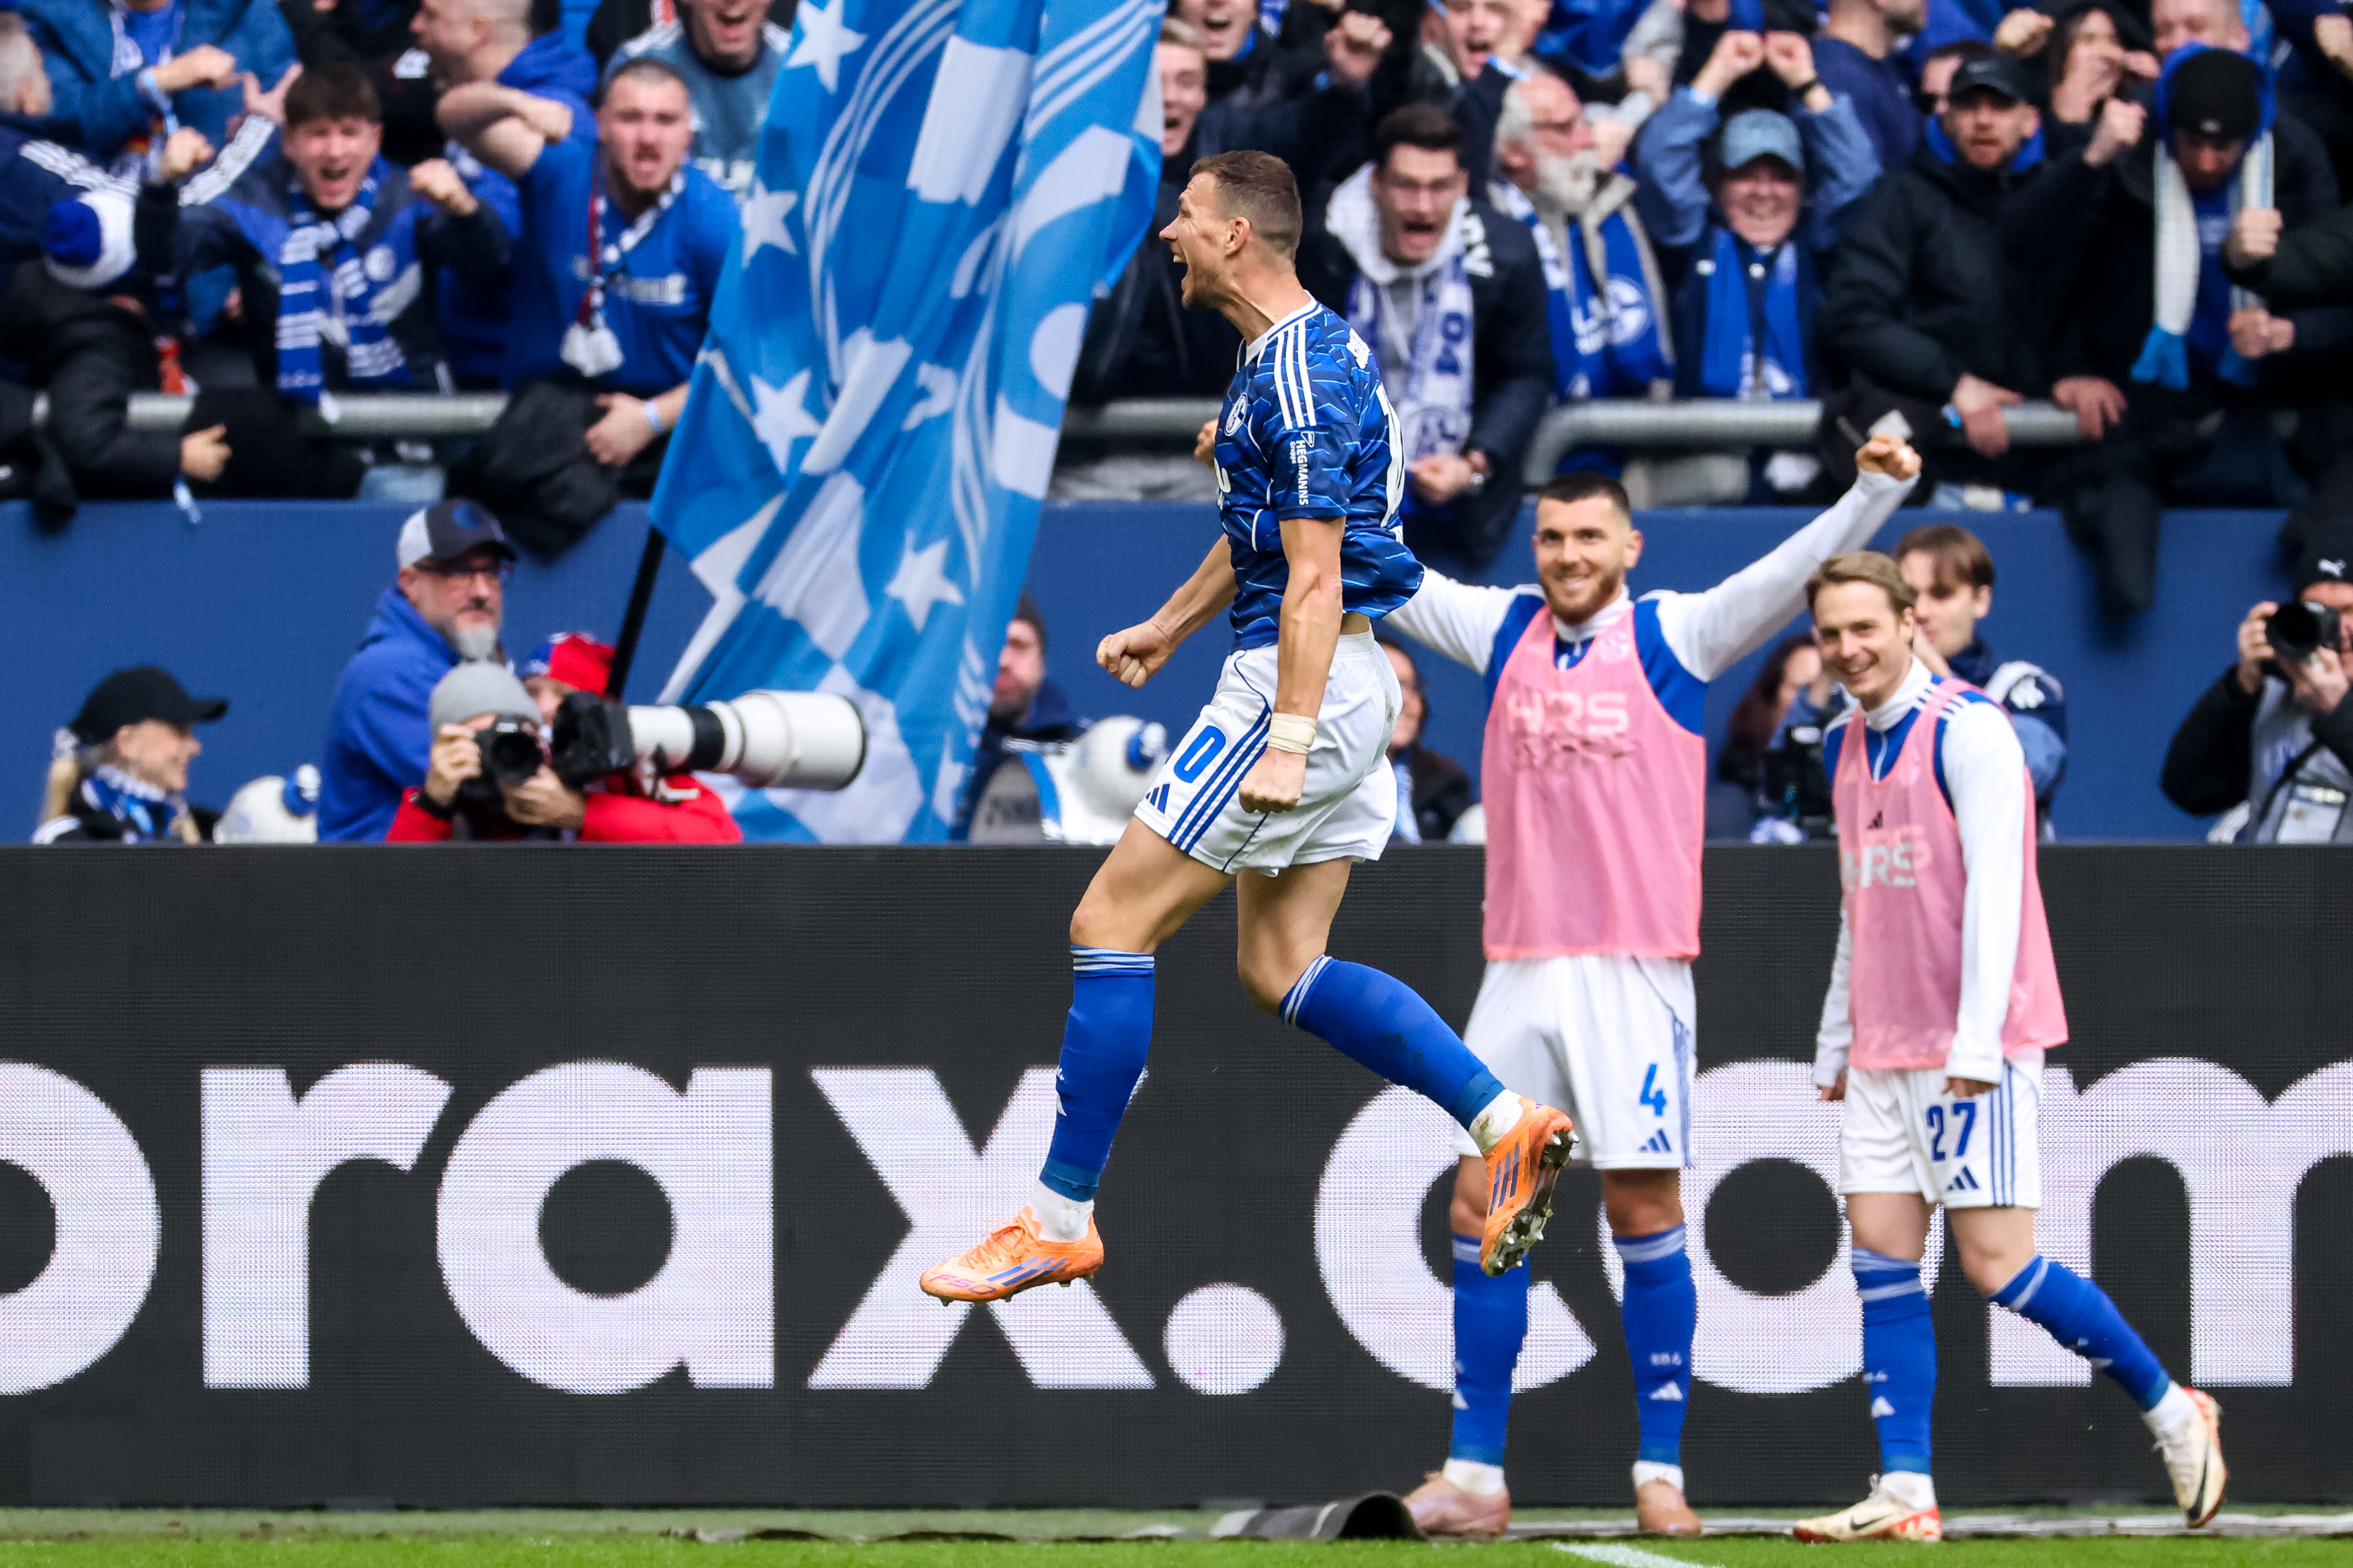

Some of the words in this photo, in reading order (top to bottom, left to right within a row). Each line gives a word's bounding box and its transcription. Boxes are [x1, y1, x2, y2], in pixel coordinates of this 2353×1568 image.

[1296, 440, 1309, 505] HEGMANNS
[1506, 692, 1629, 735] HRS
[1165, 725, 1226, 784] 0
[1640, 1063, 1667, 1116] 4
[1927, 1101, 1976, 1161] 27
